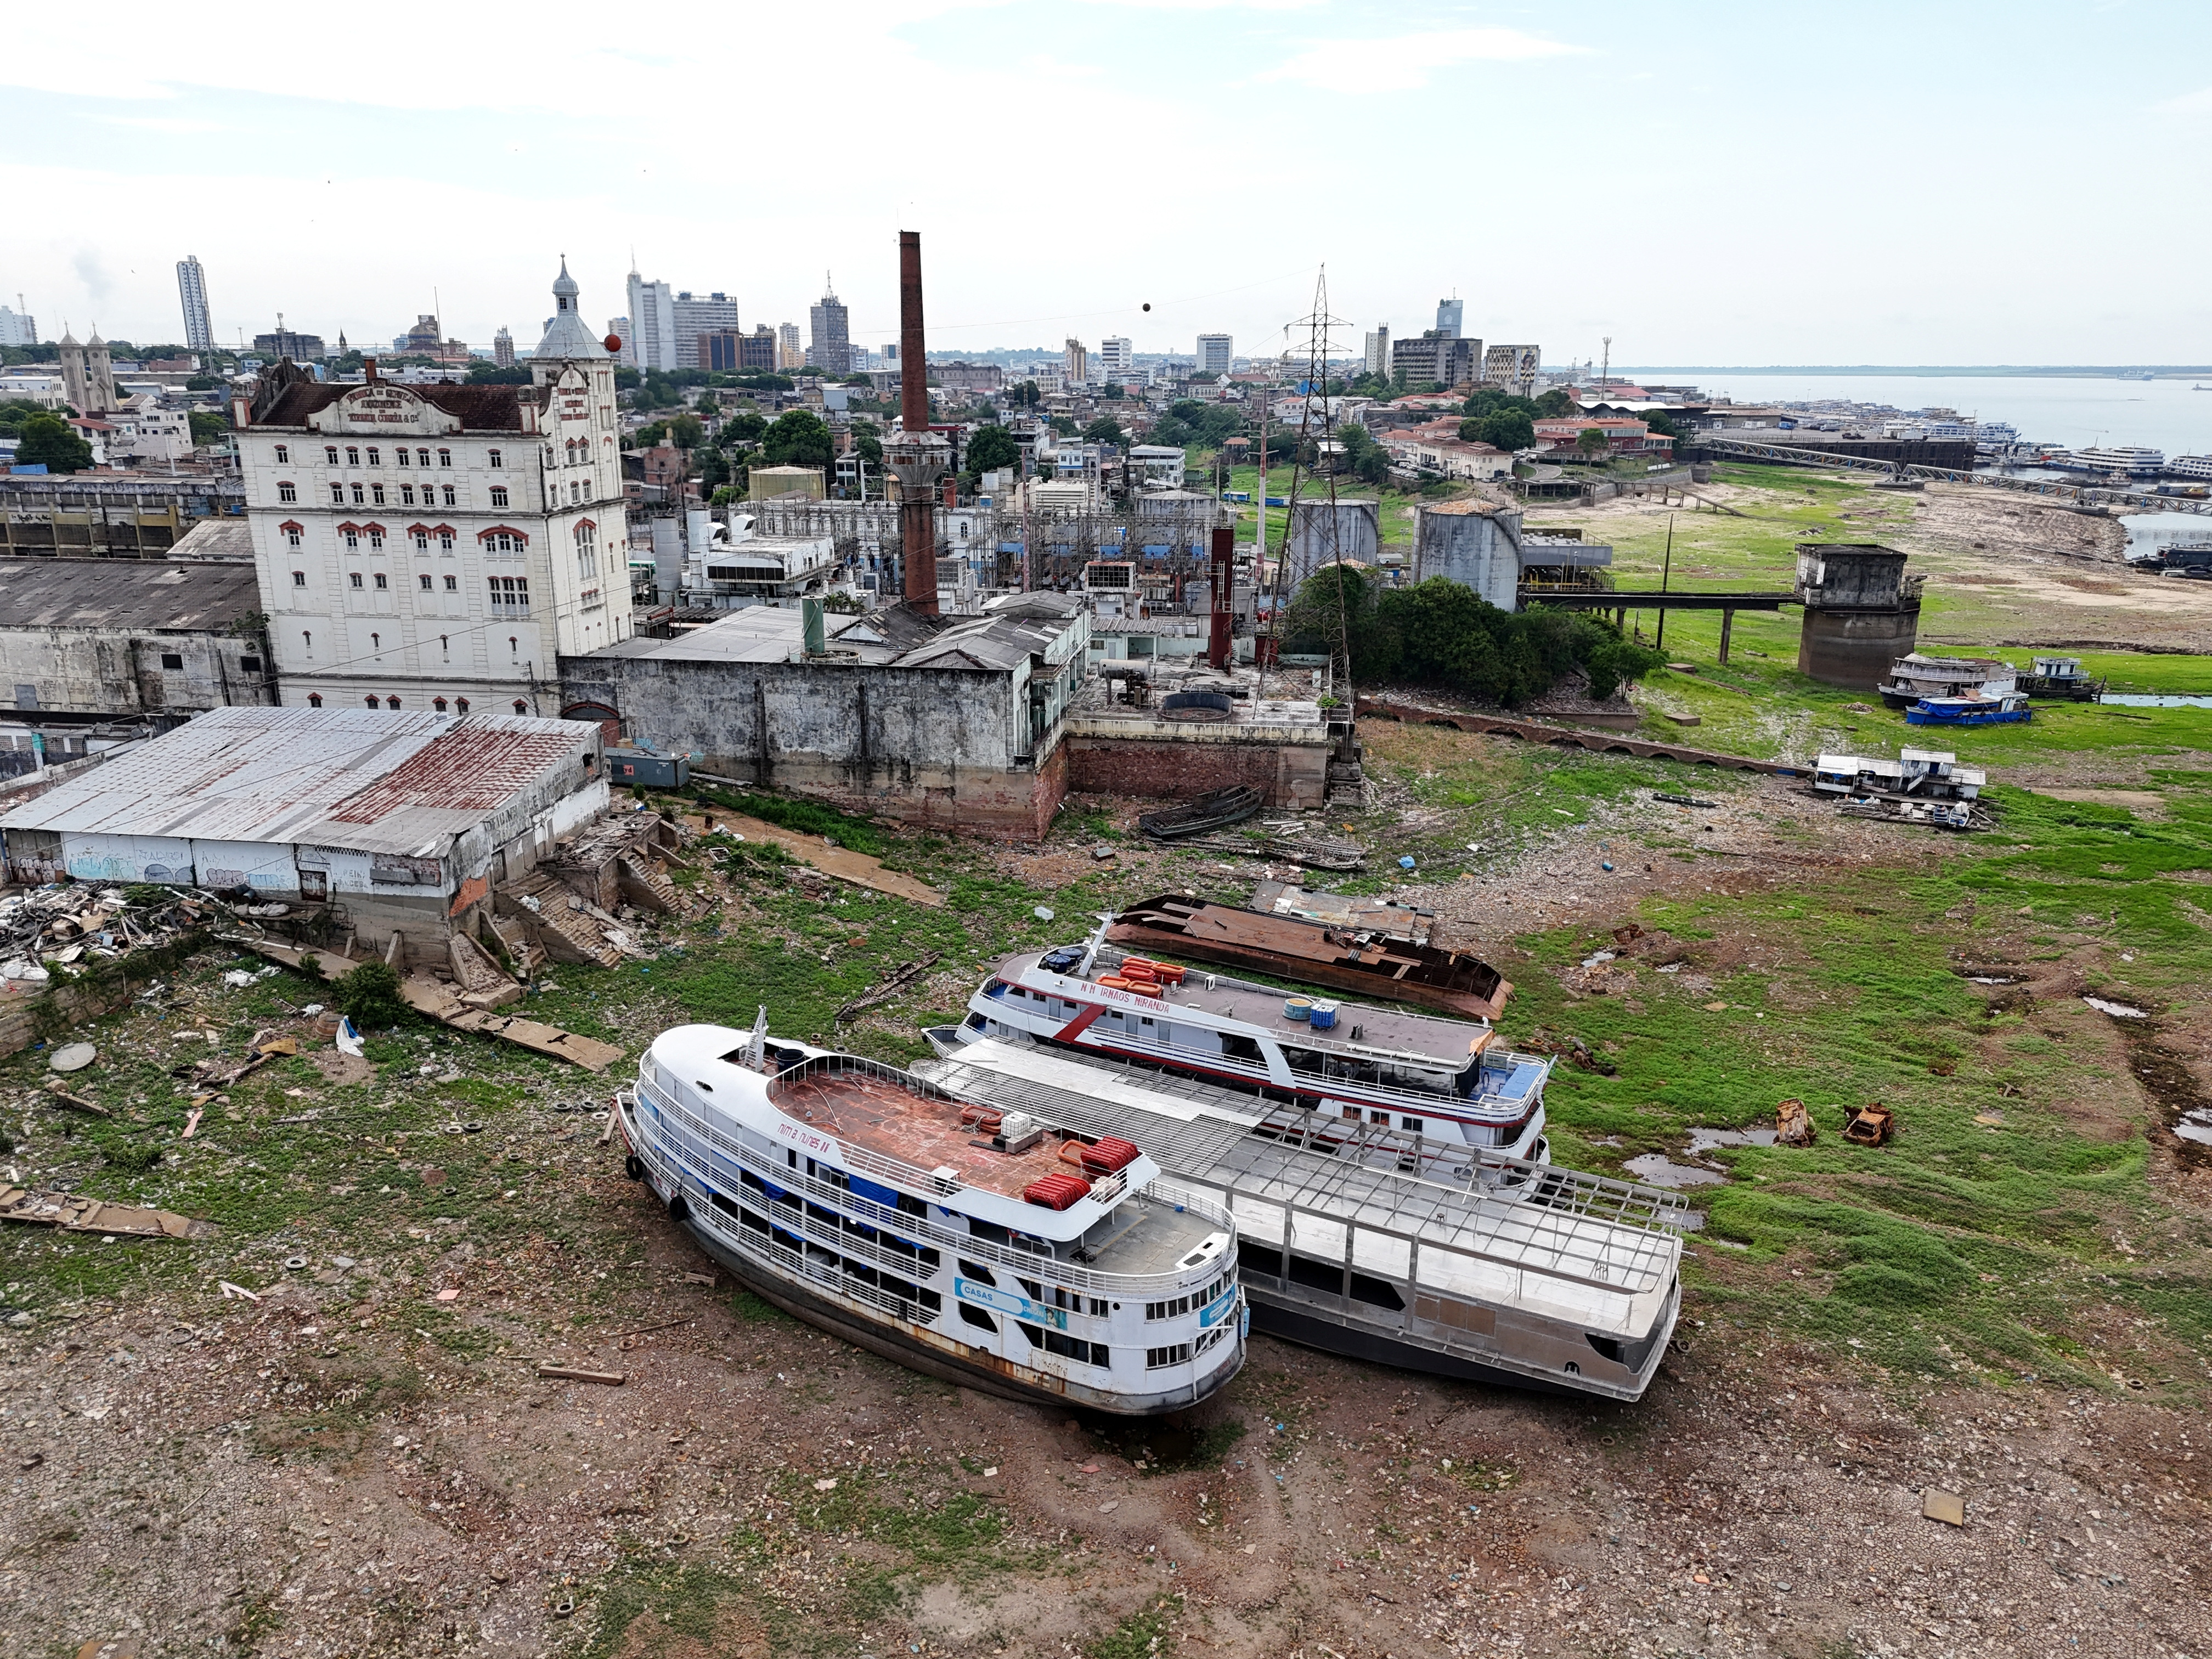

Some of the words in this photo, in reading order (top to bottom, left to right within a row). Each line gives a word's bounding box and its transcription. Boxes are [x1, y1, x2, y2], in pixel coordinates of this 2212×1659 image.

[1080, 983, 1087, 992] N
[1089, 985, 1096, 994] M
[1134, 996, 1170, 1013] MIRANDA
[964, 1286, 992, 1301] CASAS
